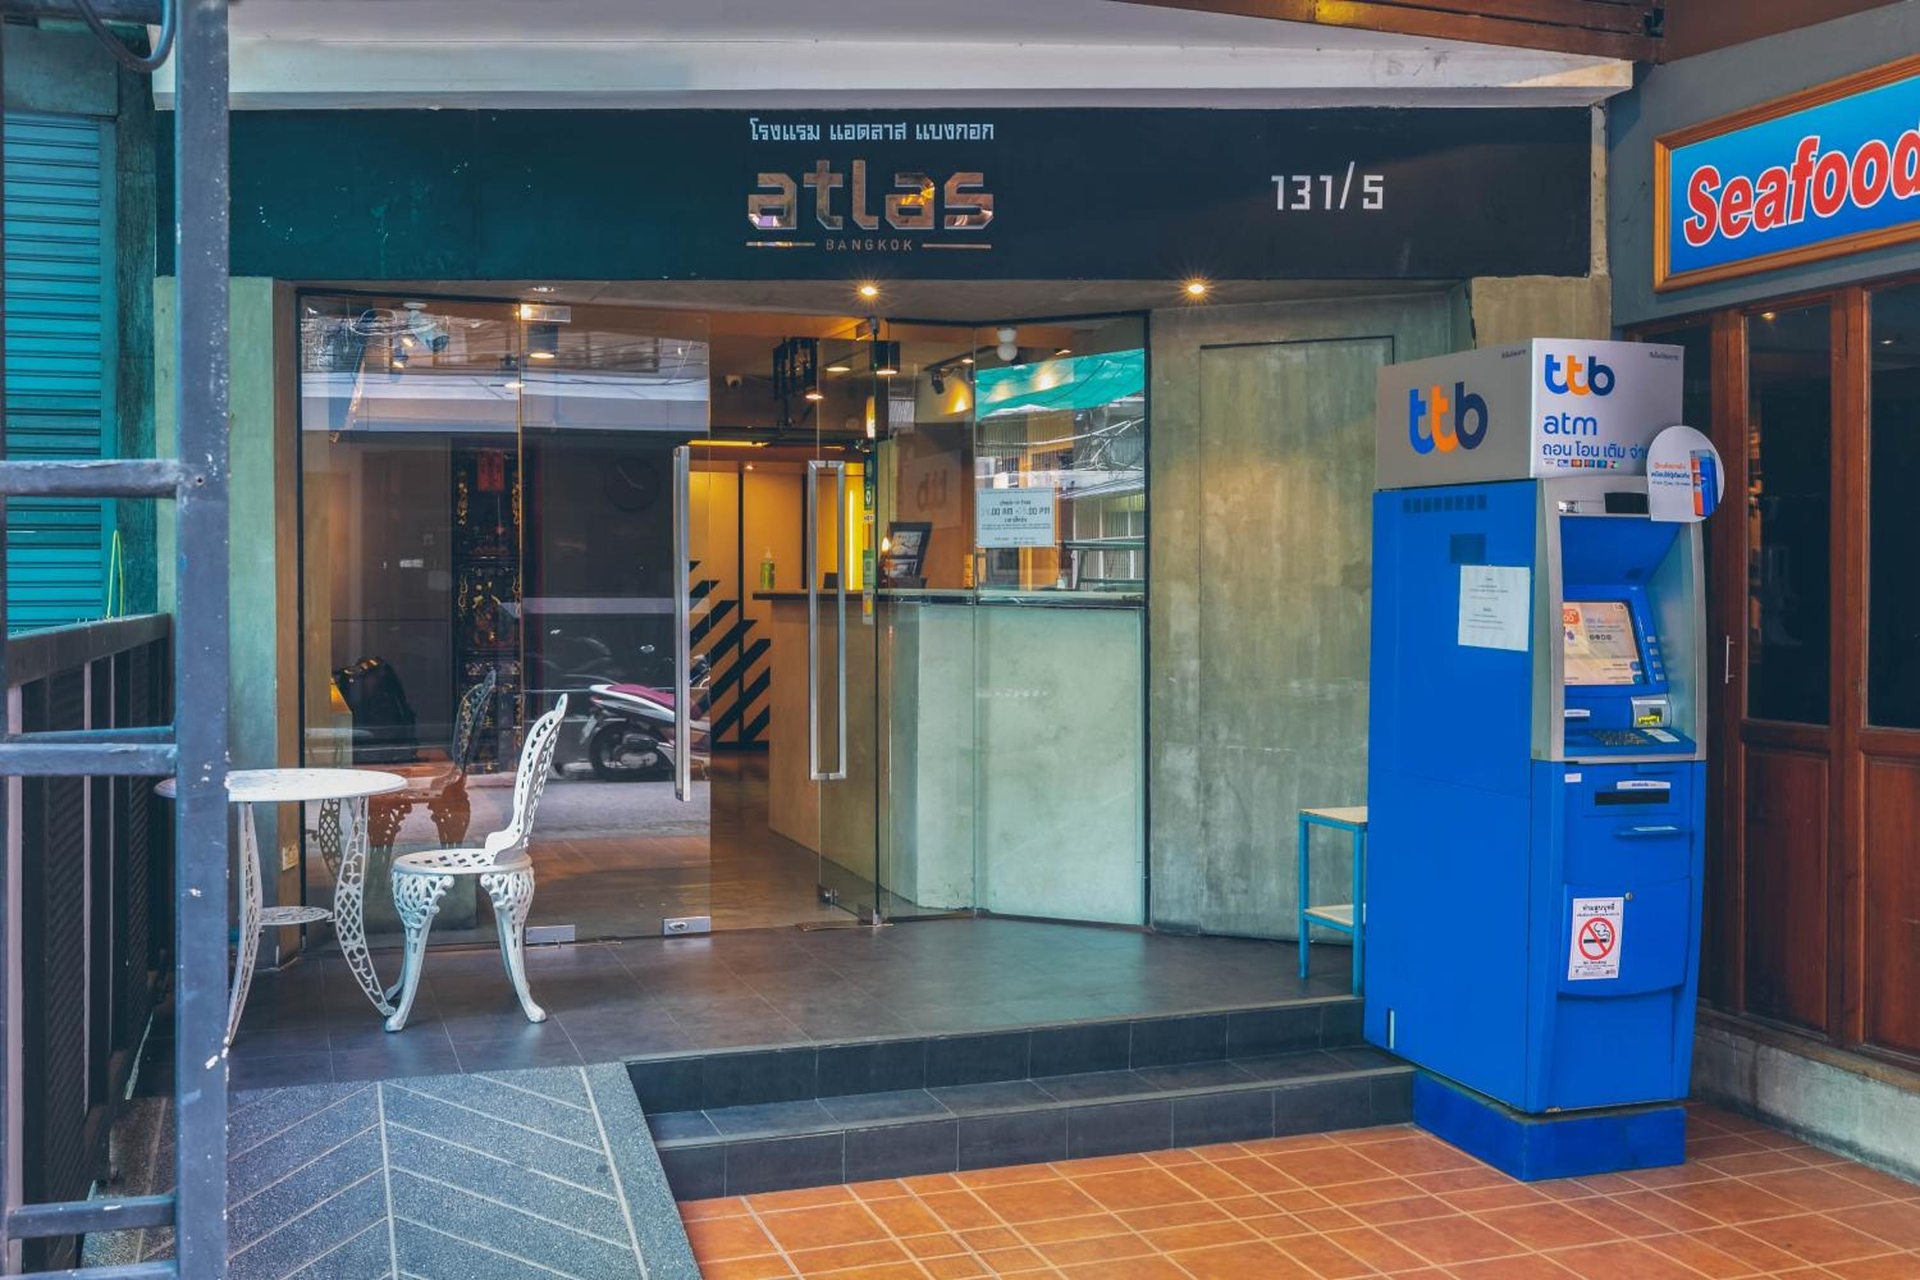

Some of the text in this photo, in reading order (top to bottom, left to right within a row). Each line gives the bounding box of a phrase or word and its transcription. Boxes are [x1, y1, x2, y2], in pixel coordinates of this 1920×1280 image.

[749, 118, 820, 141] โรงแรม
[915, 123, 995, 141] แบงกอก
[748, 159, 994, 231] atlas
[1271, 160, 1385, 211] 131/5
[1683, 120, 1920, 247] Seafood
[826, 239, 914, 251] BANGKOK
[1544, 354, 1616, 396] ttb
[1409, 381, 1488, 455] ttb
[1543, 412, 1598, 436] atm
[1543, 443, 1572, 457] ถอน
[1576, 440, 1599, 457] โอน
